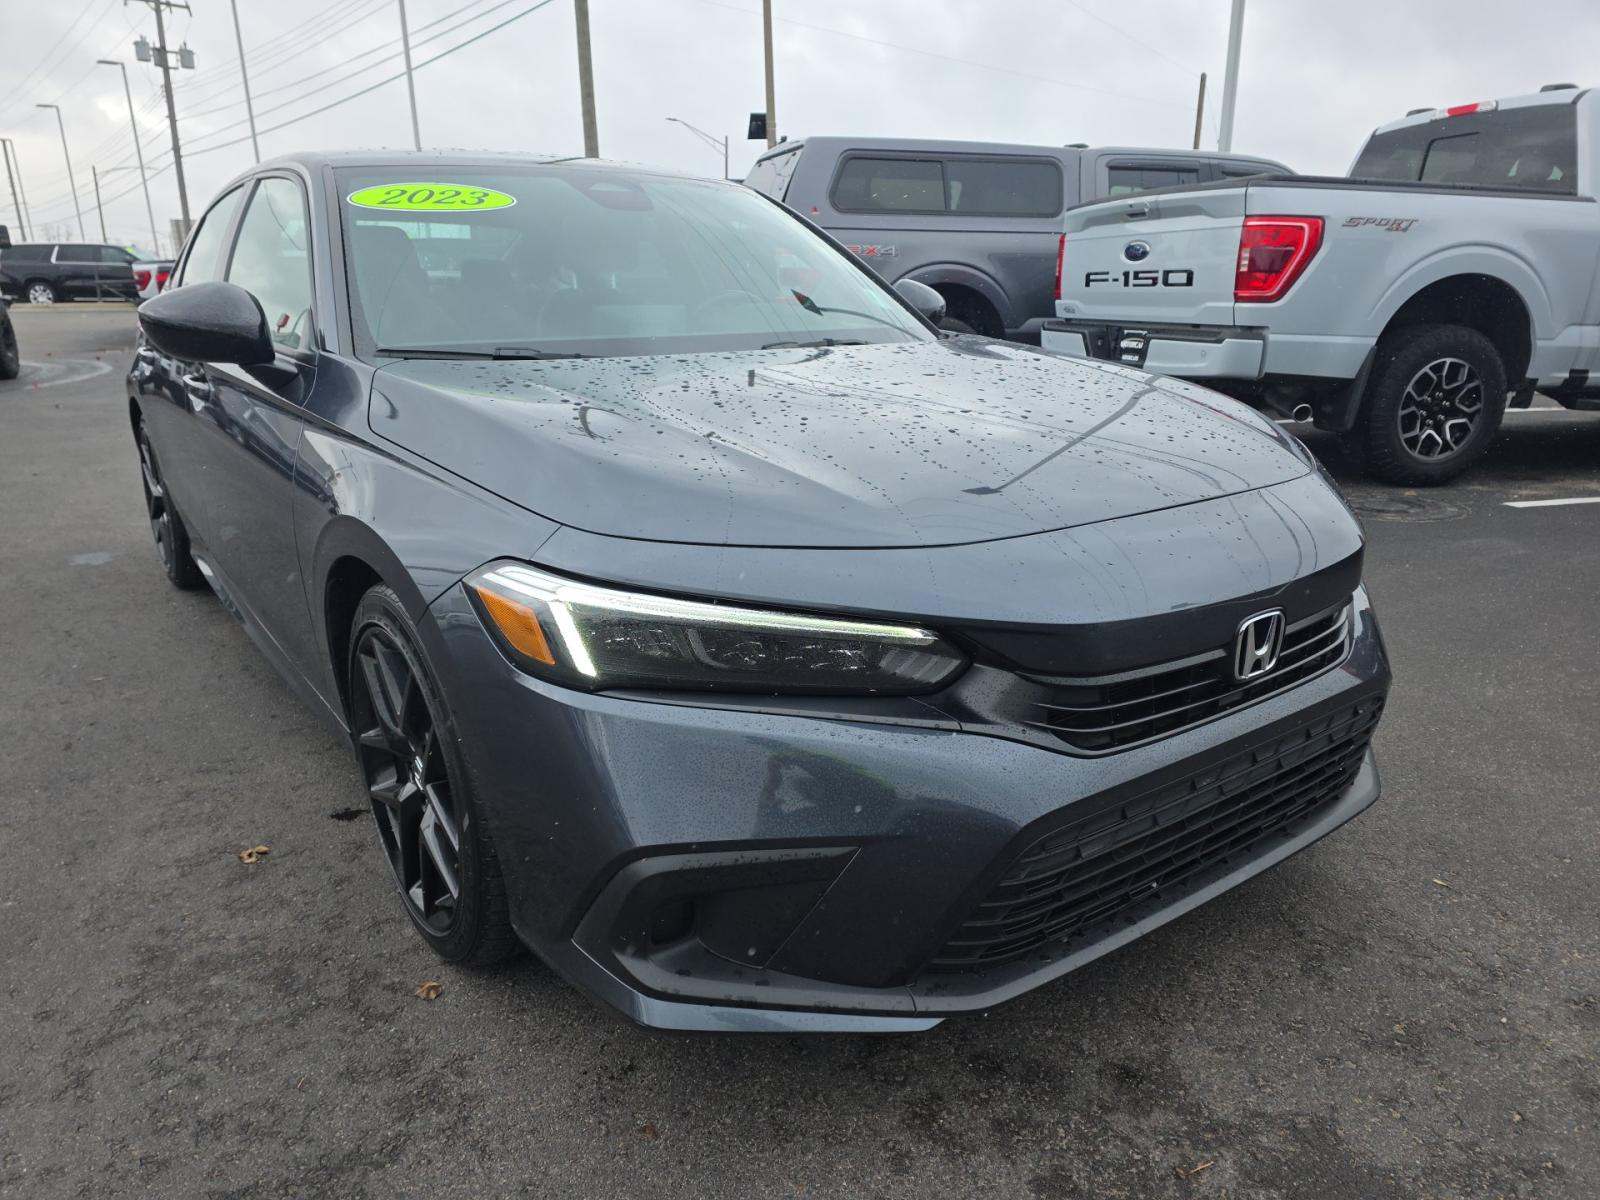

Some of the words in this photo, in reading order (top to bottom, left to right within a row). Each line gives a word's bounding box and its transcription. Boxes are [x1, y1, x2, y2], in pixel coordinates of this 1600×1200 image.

[377, 188, 490, 206] 2023
[1341, 217, 1419, 228] SPORT
[1084, 269, 1195, 288] F-150
